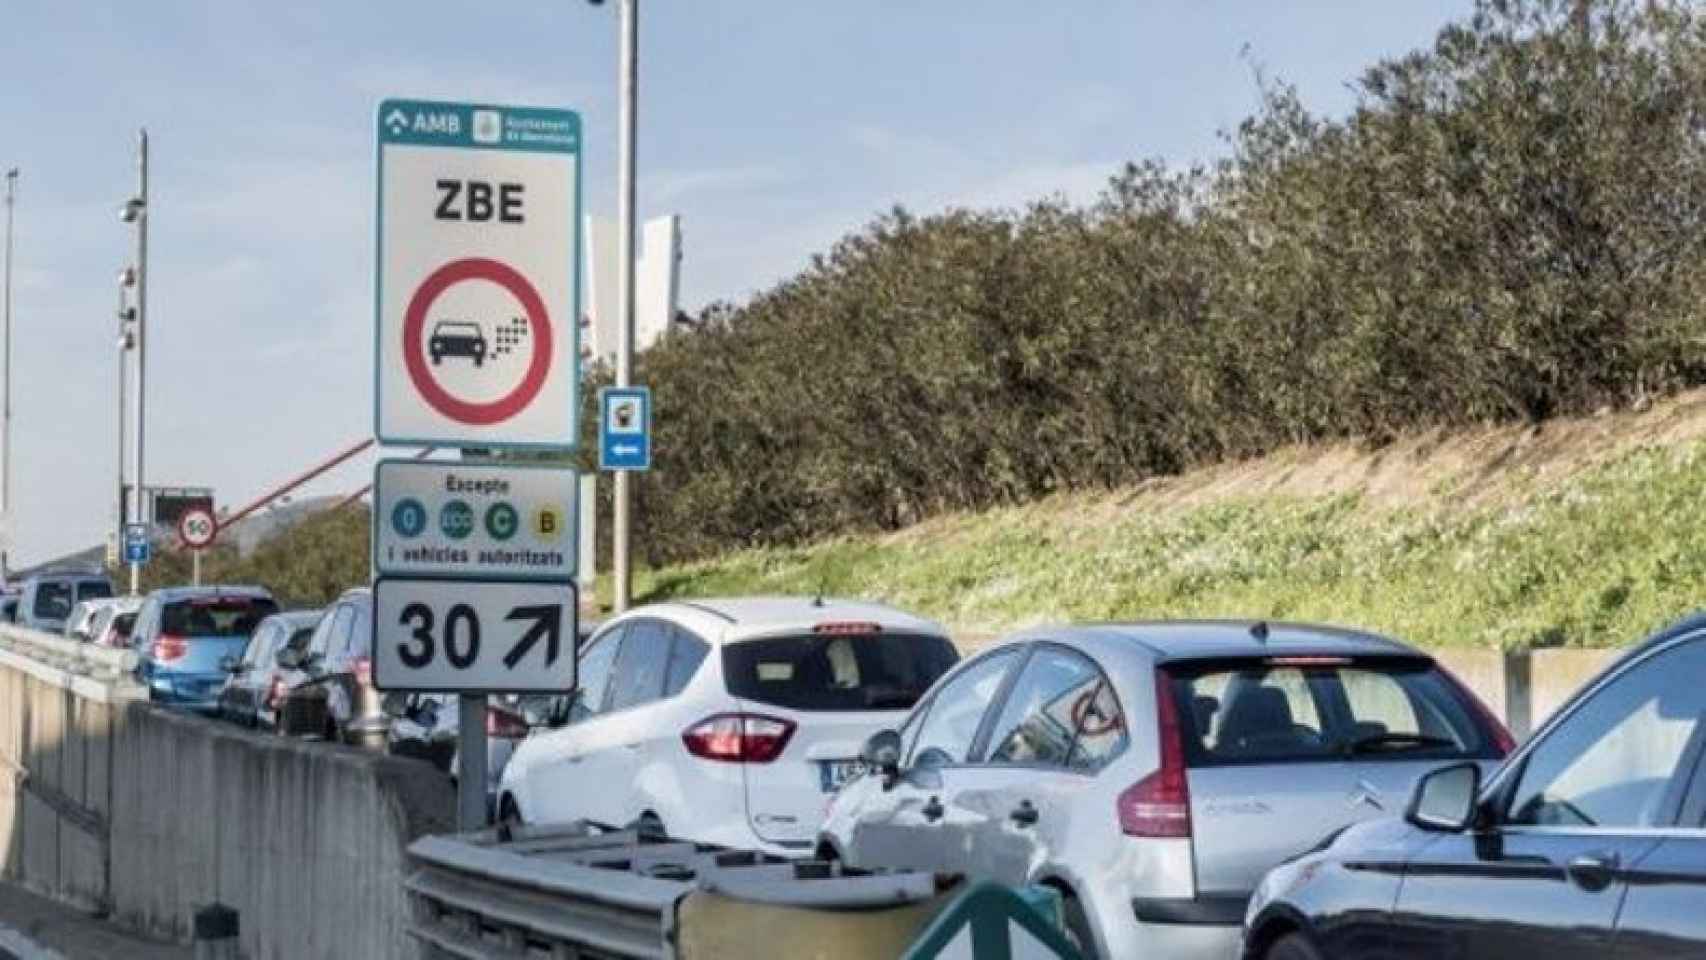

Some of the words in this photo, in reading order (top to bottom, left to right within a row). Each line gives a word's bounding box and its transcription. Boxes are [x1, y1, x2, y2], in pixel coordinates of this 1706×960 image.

[413, 107, 461, 133] AMB
[434, 180, 525, 223] ZBE
[446, 474, 510, 494] Excepte
[493, 511, 510, 533] C
[540, 511, 555, 533] B
[403, 548, 468, 564] vehicles
[479, 550, 563, 568] autoritzats
[398, 602, 480, 669] 30
